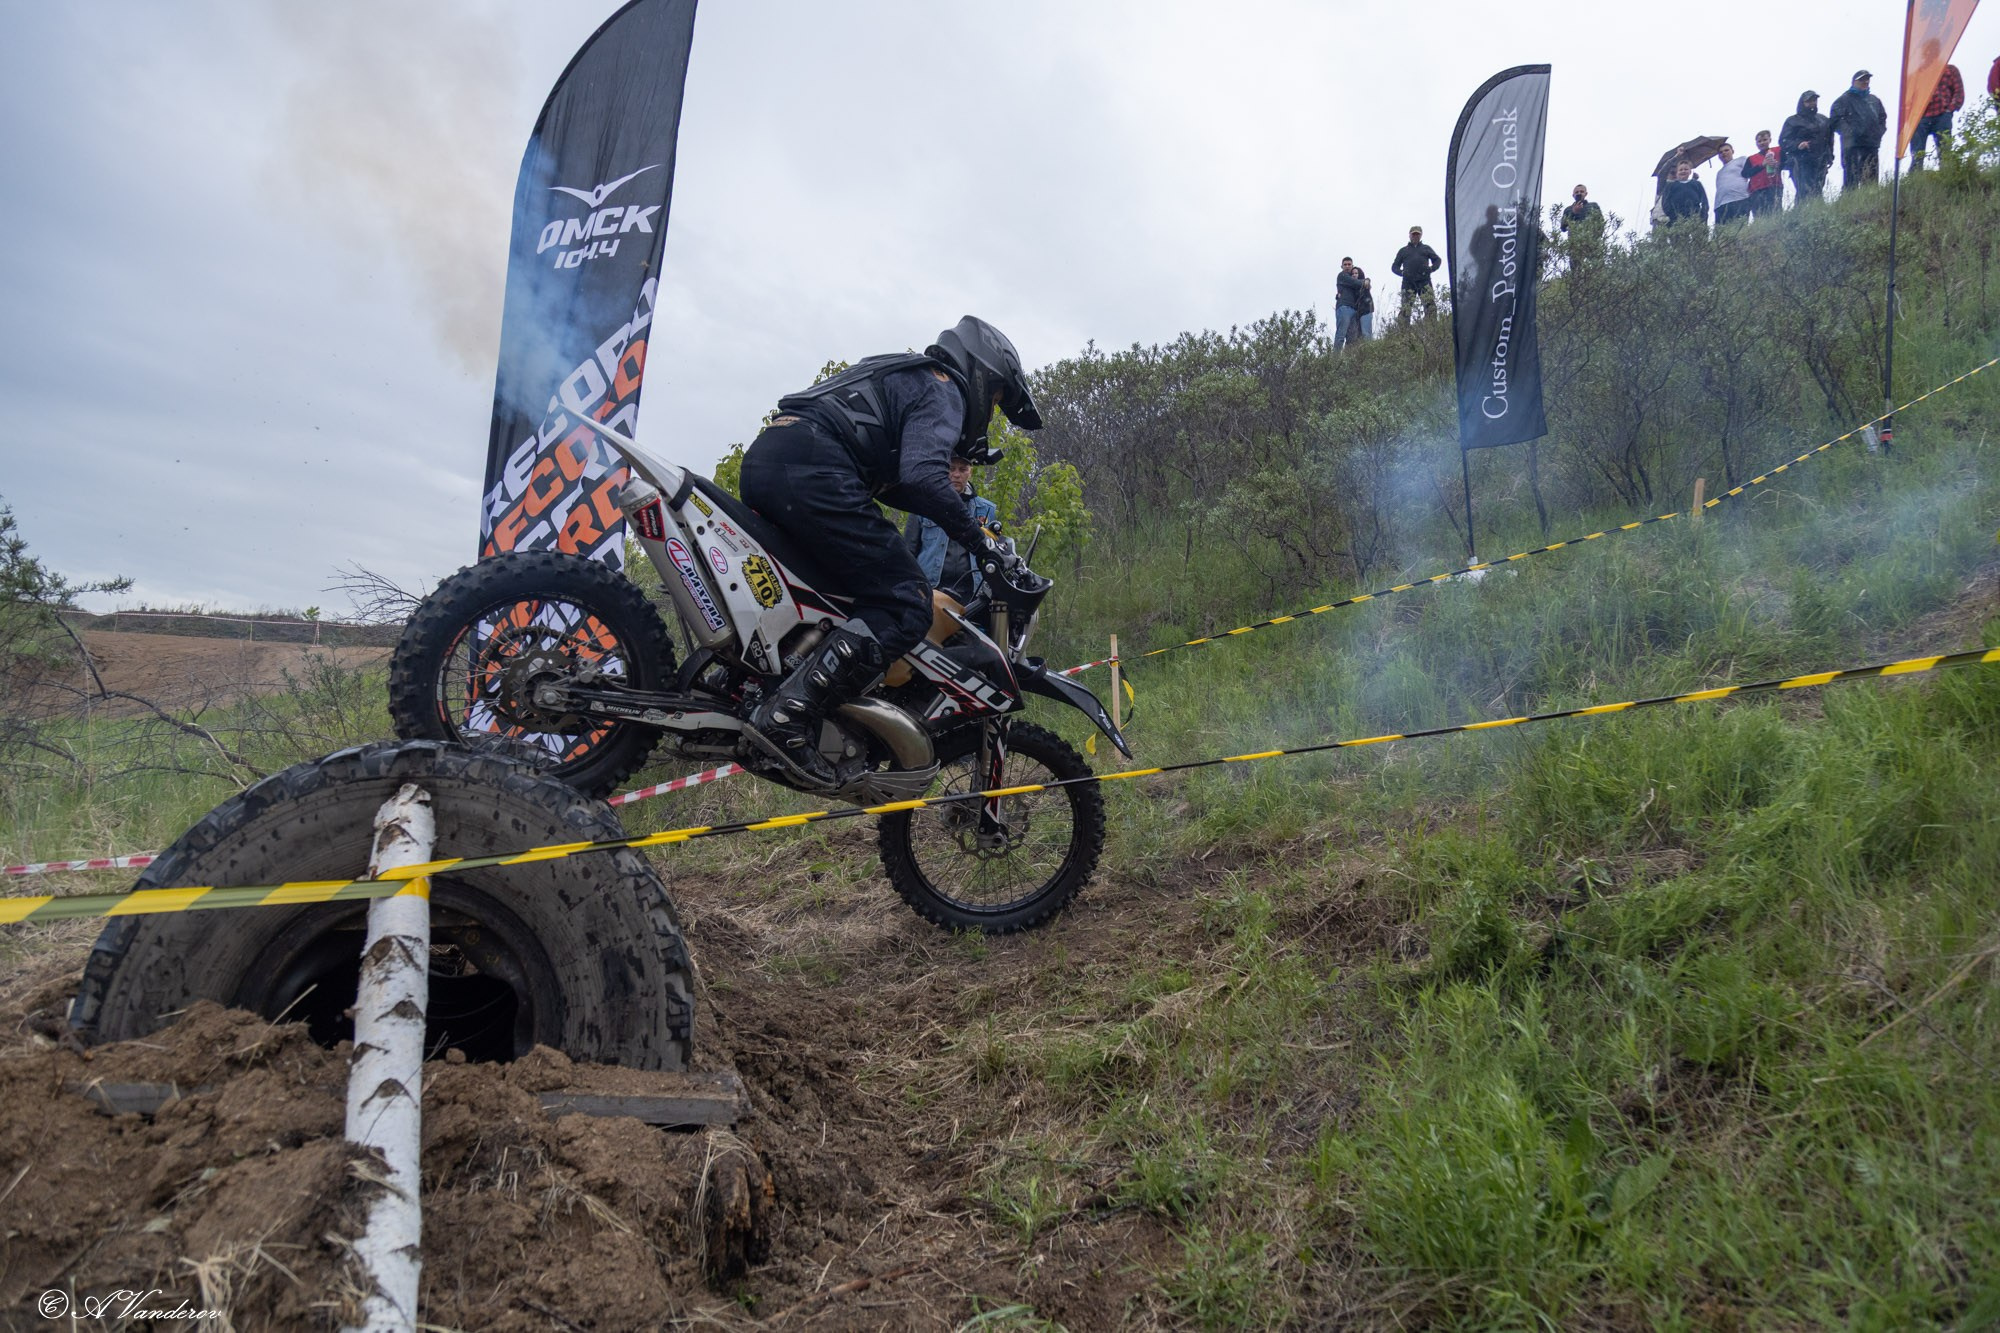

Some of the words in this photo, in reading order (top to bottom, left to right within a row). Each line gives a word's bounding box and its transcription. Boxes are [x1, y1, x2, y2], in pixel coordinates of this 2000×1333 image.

[553, 239, 621, 269] 104.4
[749, 562, 772, 601] 710
[910, 641, 1015, 713] IEJU
[606, 705, 640, 715] MICHELIN
